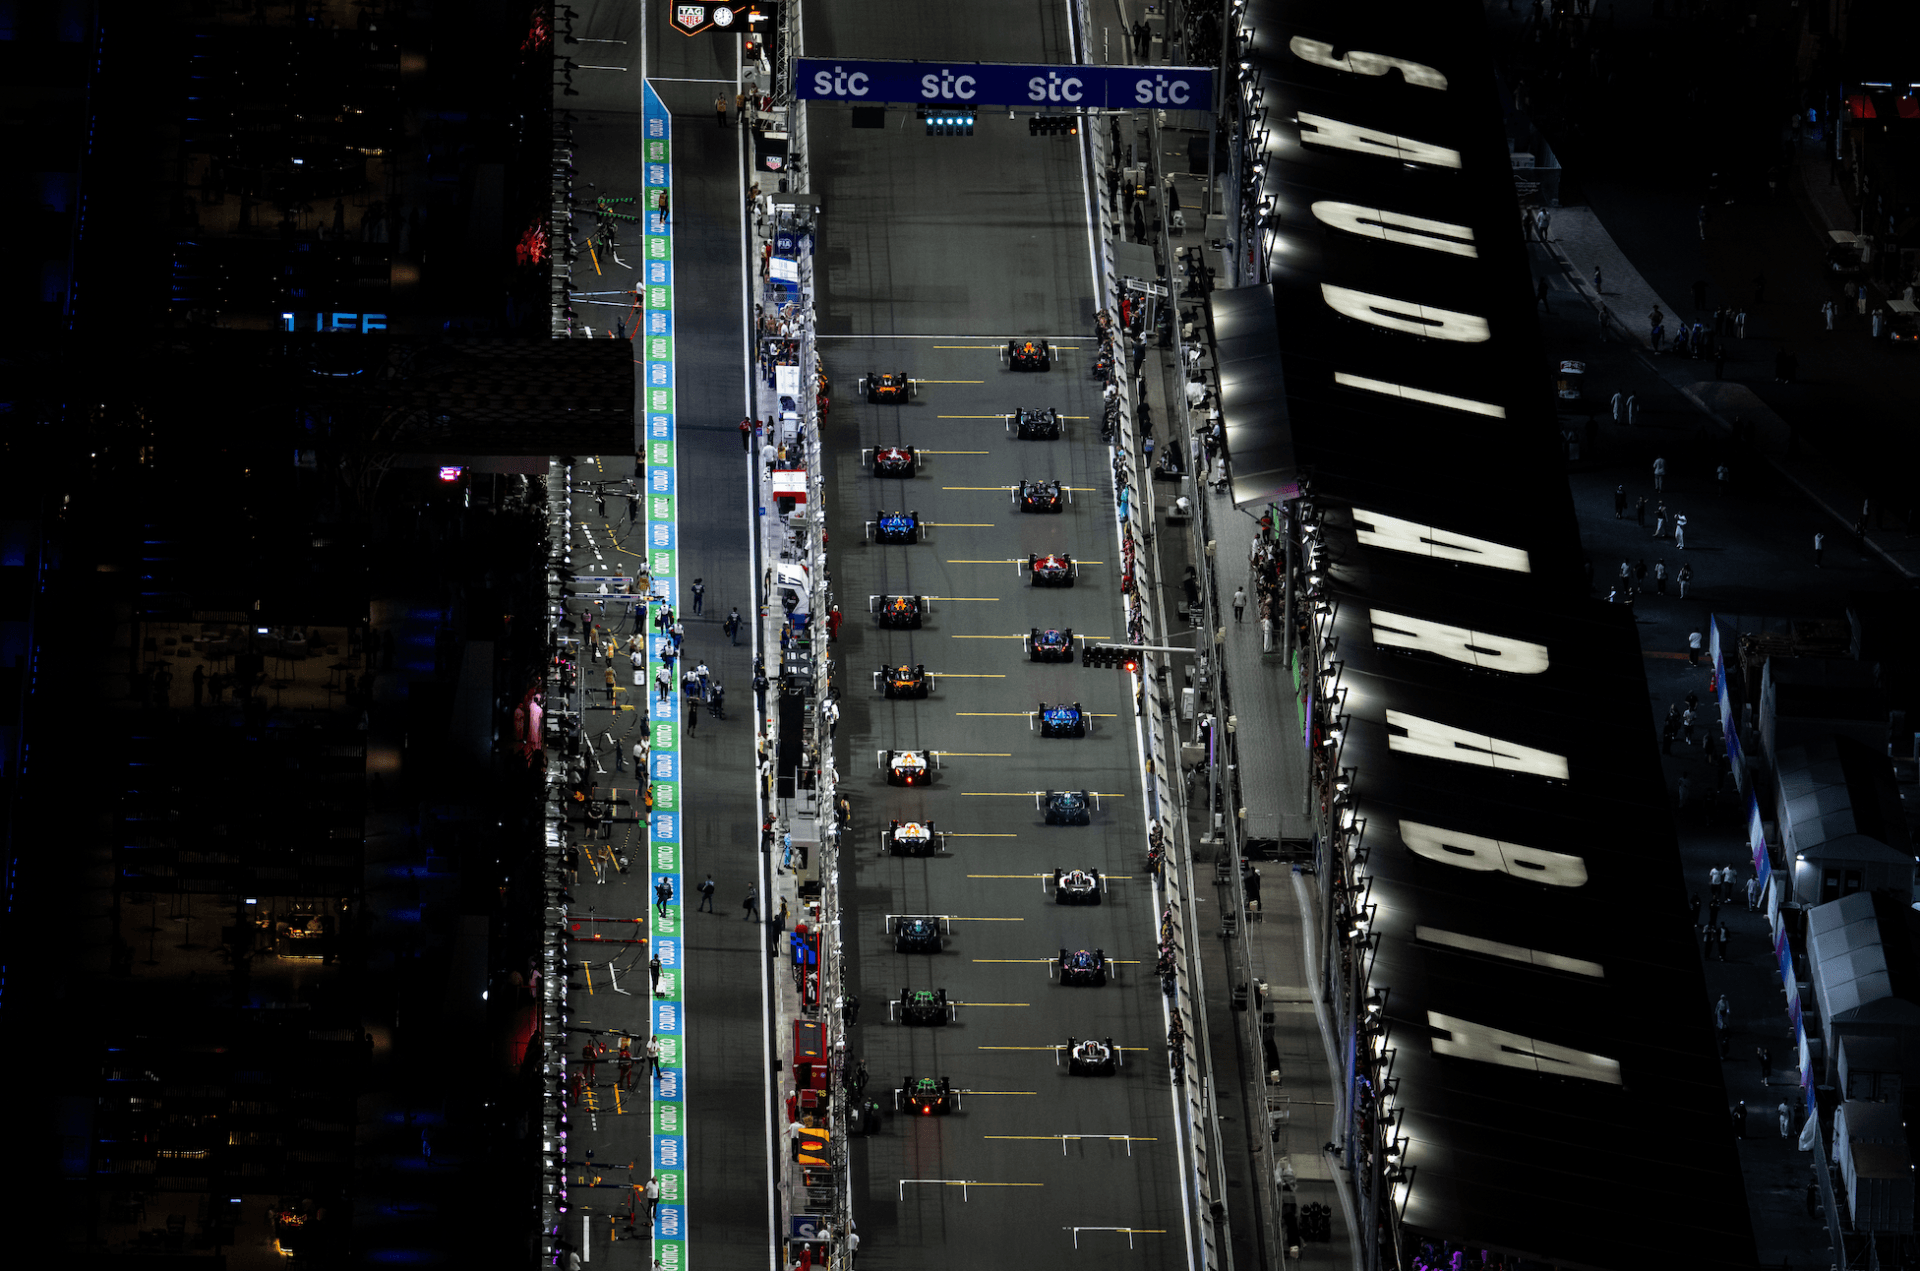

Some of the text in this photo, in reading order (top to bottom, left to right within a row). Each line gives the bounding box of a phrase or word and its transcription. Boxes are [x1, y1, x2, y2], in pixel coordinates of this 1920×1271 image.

[814, 66, 869, 96] stc
[921, 69, 976, 99] stc
[1028, 72, 1083, 101] stc
[1135, 75, 1190, 104] stc
[650, 118, 664, 137] aramco
[650, 165, 664, 184] aramco
[651, 238, 665, 258] aramco
[651, 262, 666, 282] aramco
[652, 288, 666, 307] aramco
[652, 313, 666, 333] aramco
[652, 338, 667, 358] aramco
[652, 363, 667, 384] aramco
[653, 390, 668, 411] aramco
[653, 416, 668, 437] aramco
[653, 443, 668, 464] aramco
[654, 469, 669, 491] aramco
[654, 497, 669, 518] aramco
[654, 524, 669, 546] aramco
[655, 552, 670, 574] aramco
[1289, 35, 1622, 1086] SAUDI ARABIA
[656, 725, 672, 748] aramco
[657, 754, 672, 778] aramco
[657, 784, 673, 808] aramco
[657, 815, 673, 838] aramco
[658, 846, 674, 870] aramco
[659, 940, 675, 965] aramco
[659, 1005, 676, 1030] aramco
[660, 1038, 676, 1064] aramco
[660, 1071, 676, 1098] aramco
[660, 1105, 677, 1131] aramco
[661, 1138, 677, 1164] aramco
[661, 1174, 678, 1200] aramco
[661, 1208, 678, 1235] aramco
